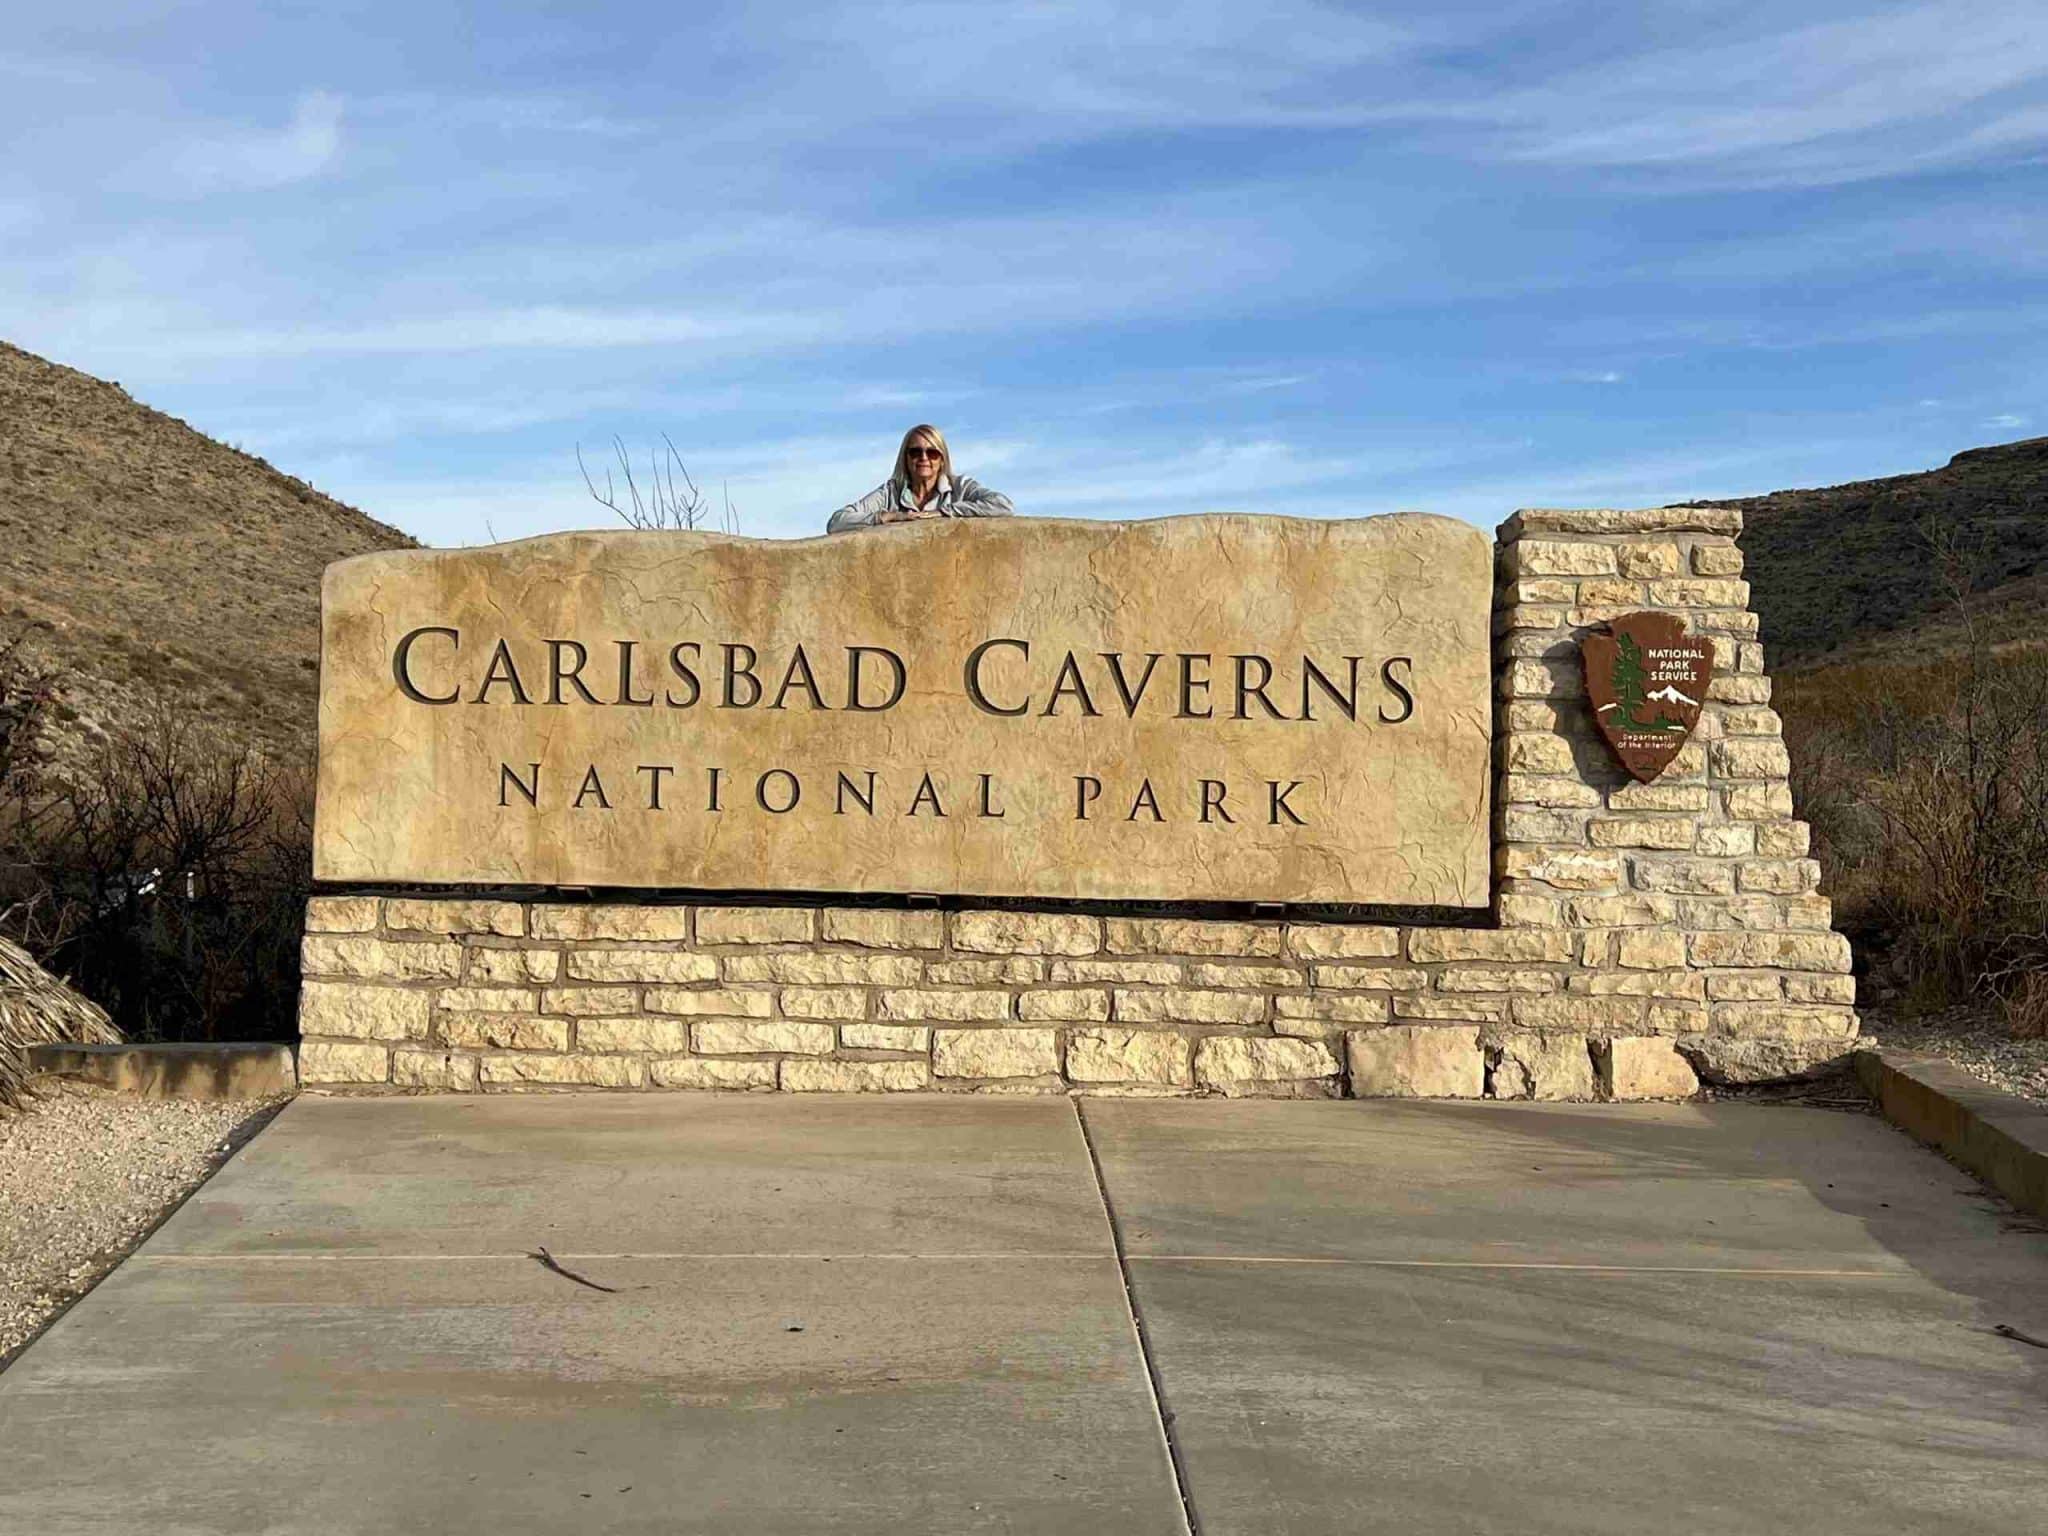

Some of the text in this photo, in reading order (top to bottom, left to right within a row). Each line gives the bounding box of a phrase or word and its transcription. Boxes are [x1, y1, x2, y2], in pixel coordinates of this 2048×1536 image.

[1648, 649, 1704, 659] NATIONAL
[1660, 661, 1689, 670] PARK
[392, 626, 1414, 724] CARLSBAD CAVERNS
[1650, 671, 1697, 681] SERVICE
[497, 762, 1309, 826] NATIONAL PARK
